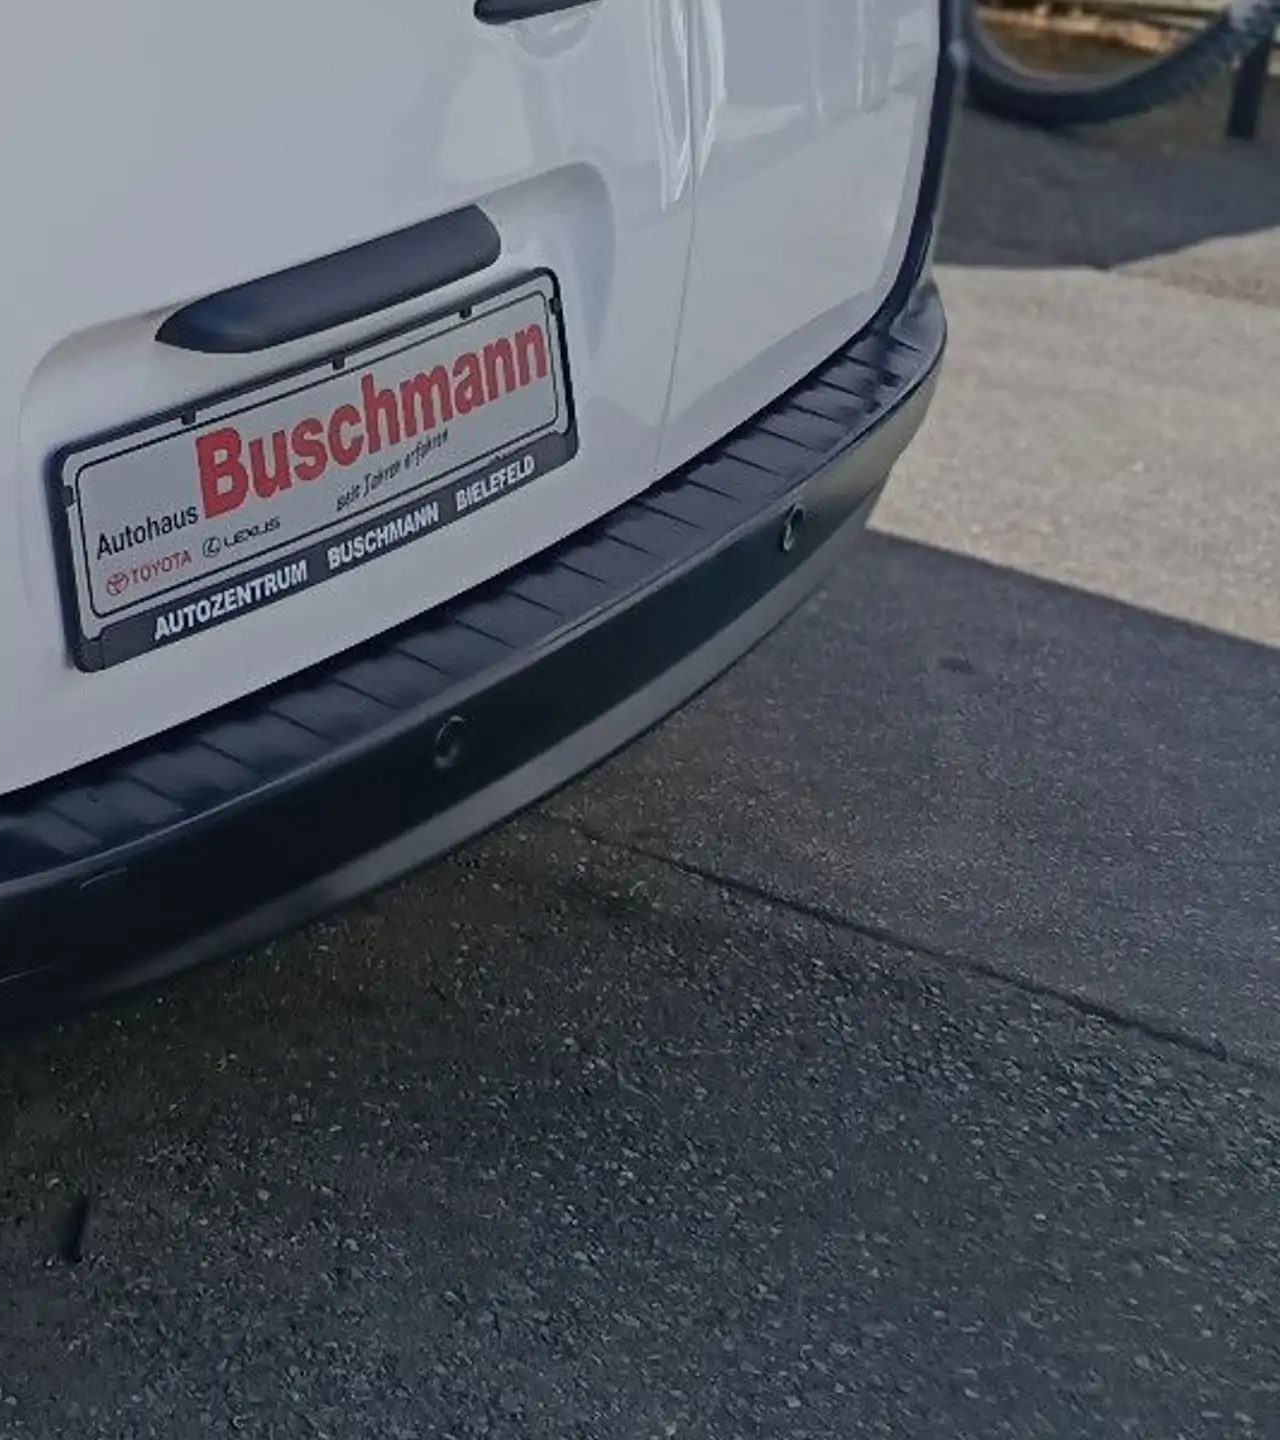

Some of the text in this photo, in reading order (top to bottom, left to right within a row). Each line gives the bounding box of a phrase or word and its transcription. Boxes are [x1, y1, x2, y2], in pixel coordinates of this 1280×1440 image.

[96, 323, 549, 560] Autohaus Buschmann
[132, 515, 282, 584] TOYOTA LEXUS
[152, 454, 536, 641] AUTOZENTRUM BUSCHMANN BIELEFELD
